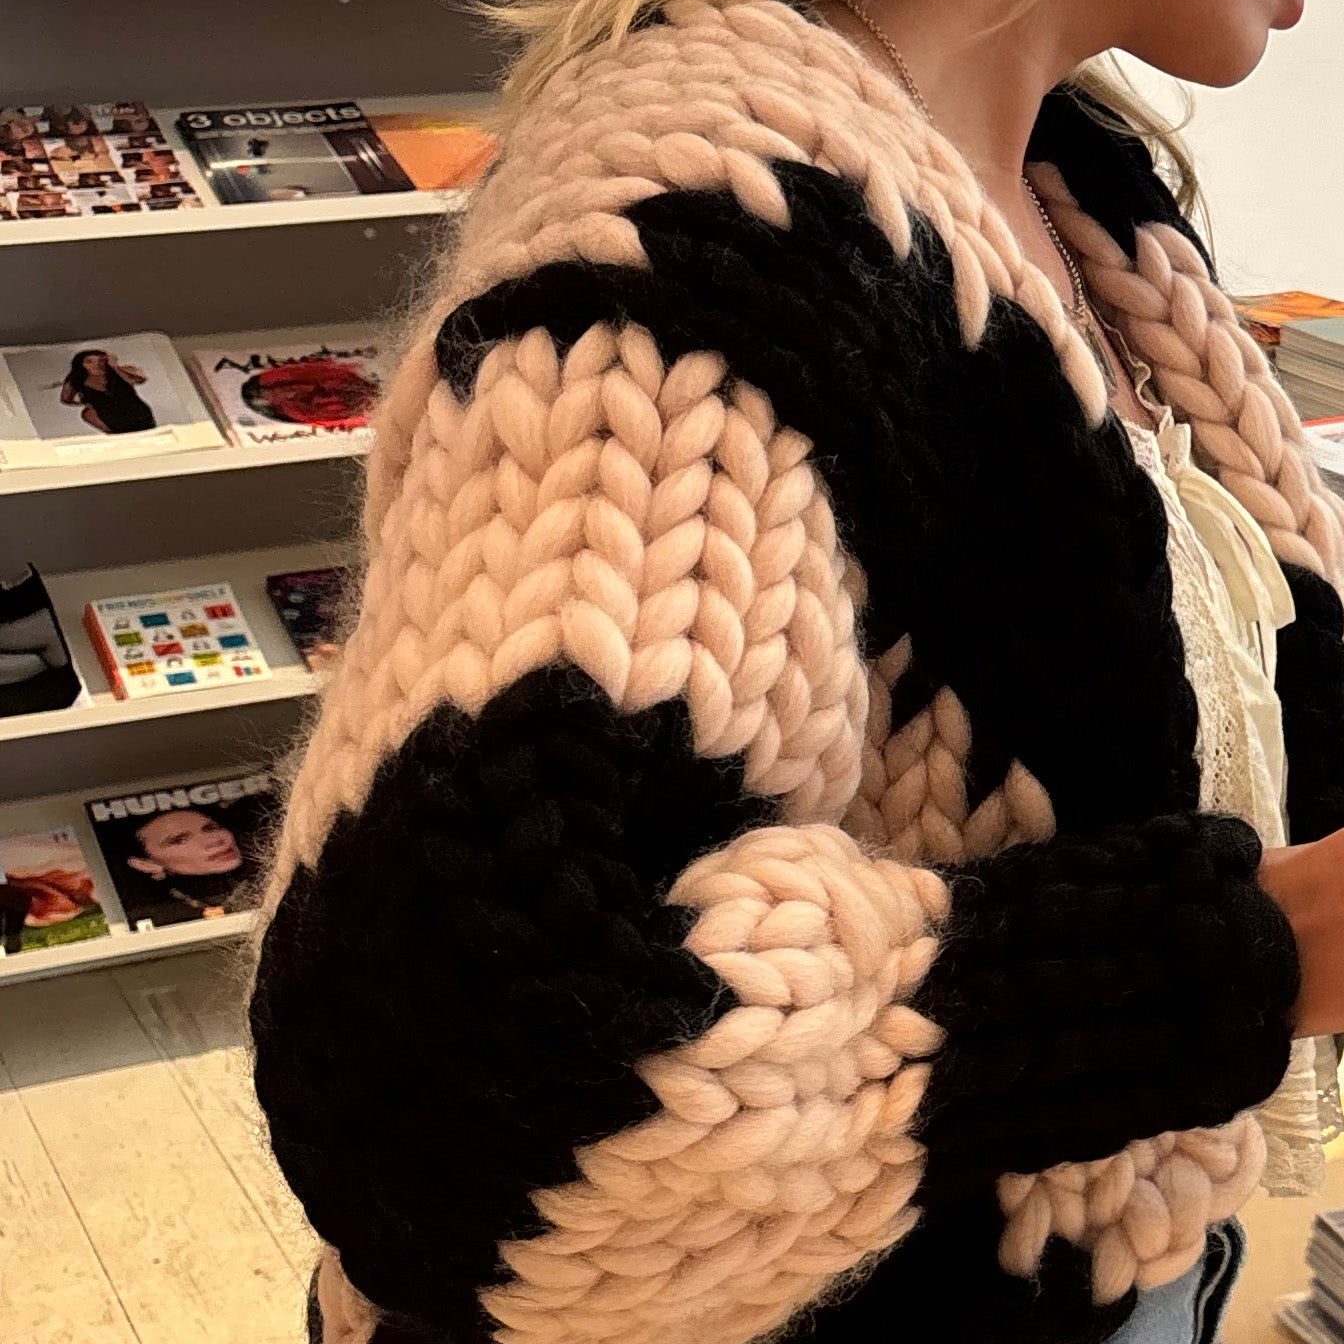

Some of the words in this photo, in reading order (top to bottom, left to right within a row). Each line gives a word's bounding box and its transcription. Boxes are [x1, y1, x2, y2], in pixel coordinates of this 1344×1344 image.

[186, 113, 212, 130] 3
[222, 103, 362, 130] objects
[92, 776, 271, 822] HUNGER
